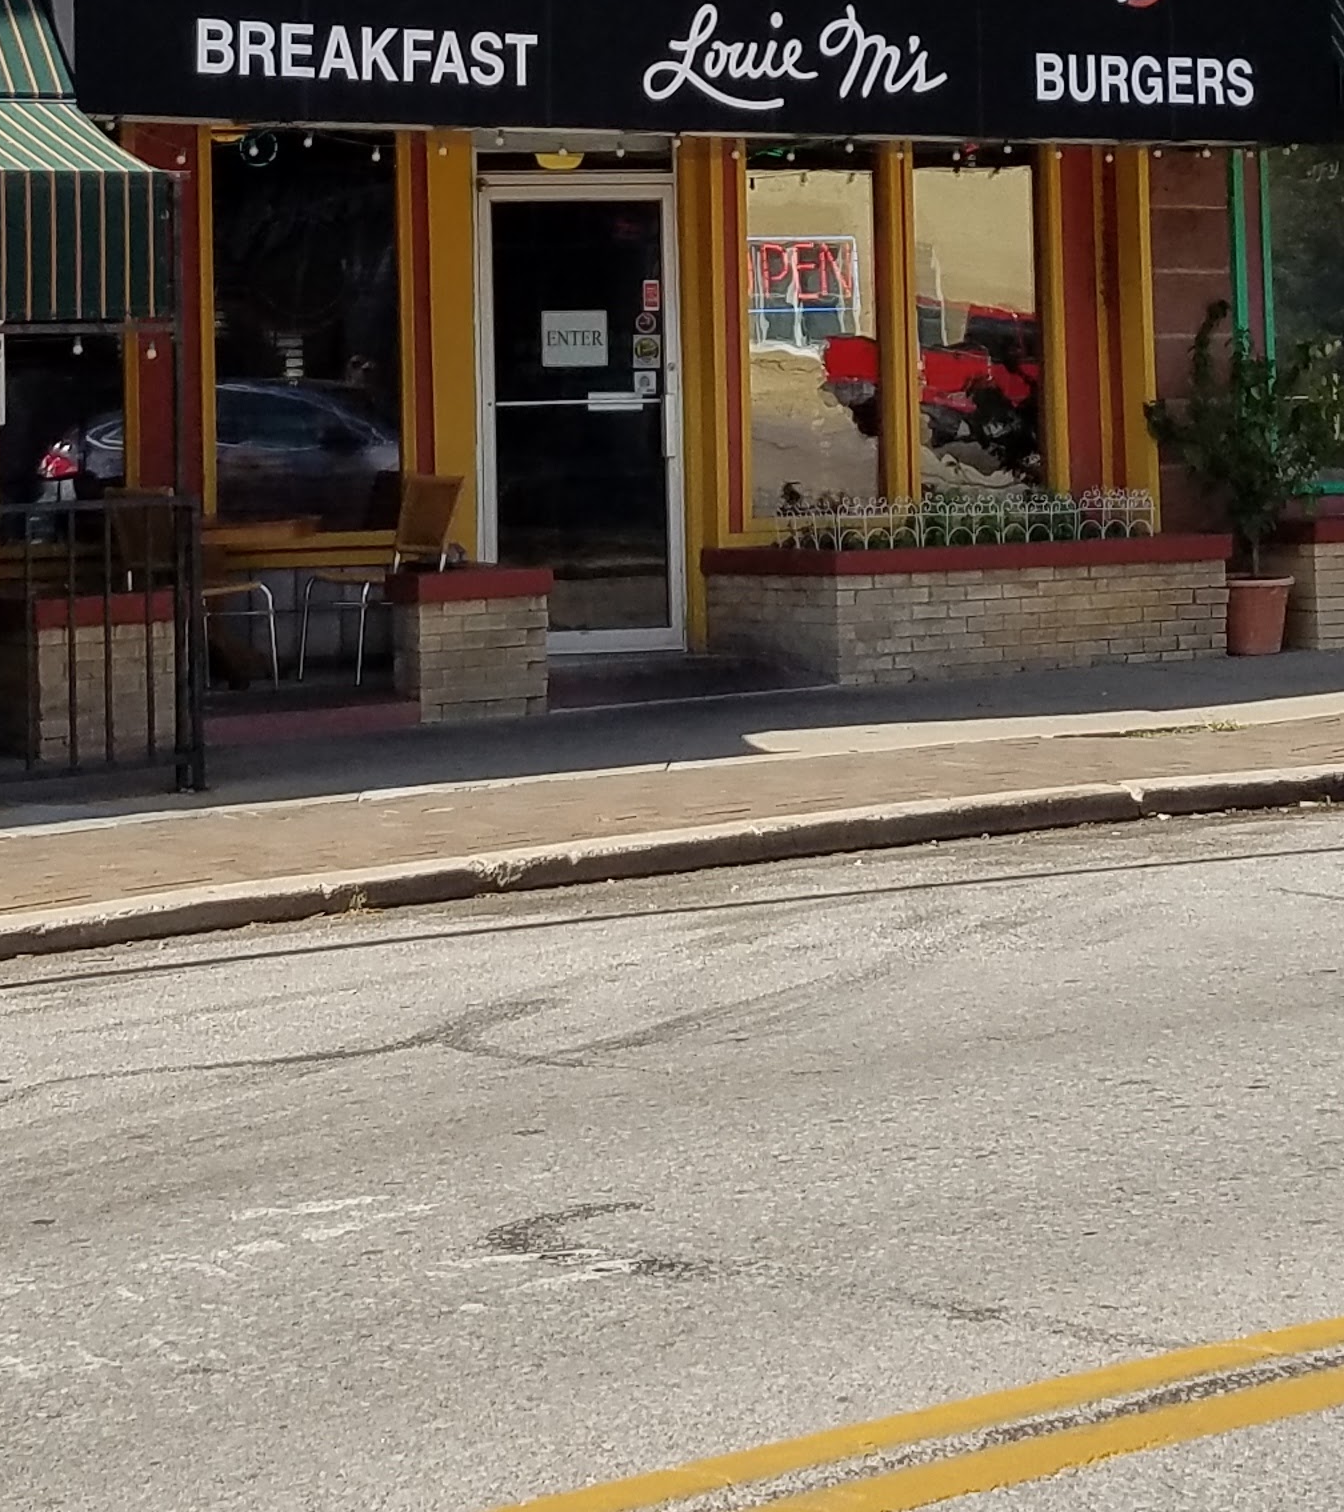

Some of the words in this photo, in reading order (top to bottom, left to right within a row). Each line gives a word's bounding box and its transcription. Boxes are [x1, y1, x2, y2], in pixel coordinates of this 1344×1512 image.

[196, 17, 538, 87] BREAKFAST
[642, 3, 819, 111] Louie
[819, 3, 948, 99] M's
[1035, 52, 1255, 107] BURGERS
[747, 242, 852, 299] PEN
[547, 330, 604, 346] ENTER
